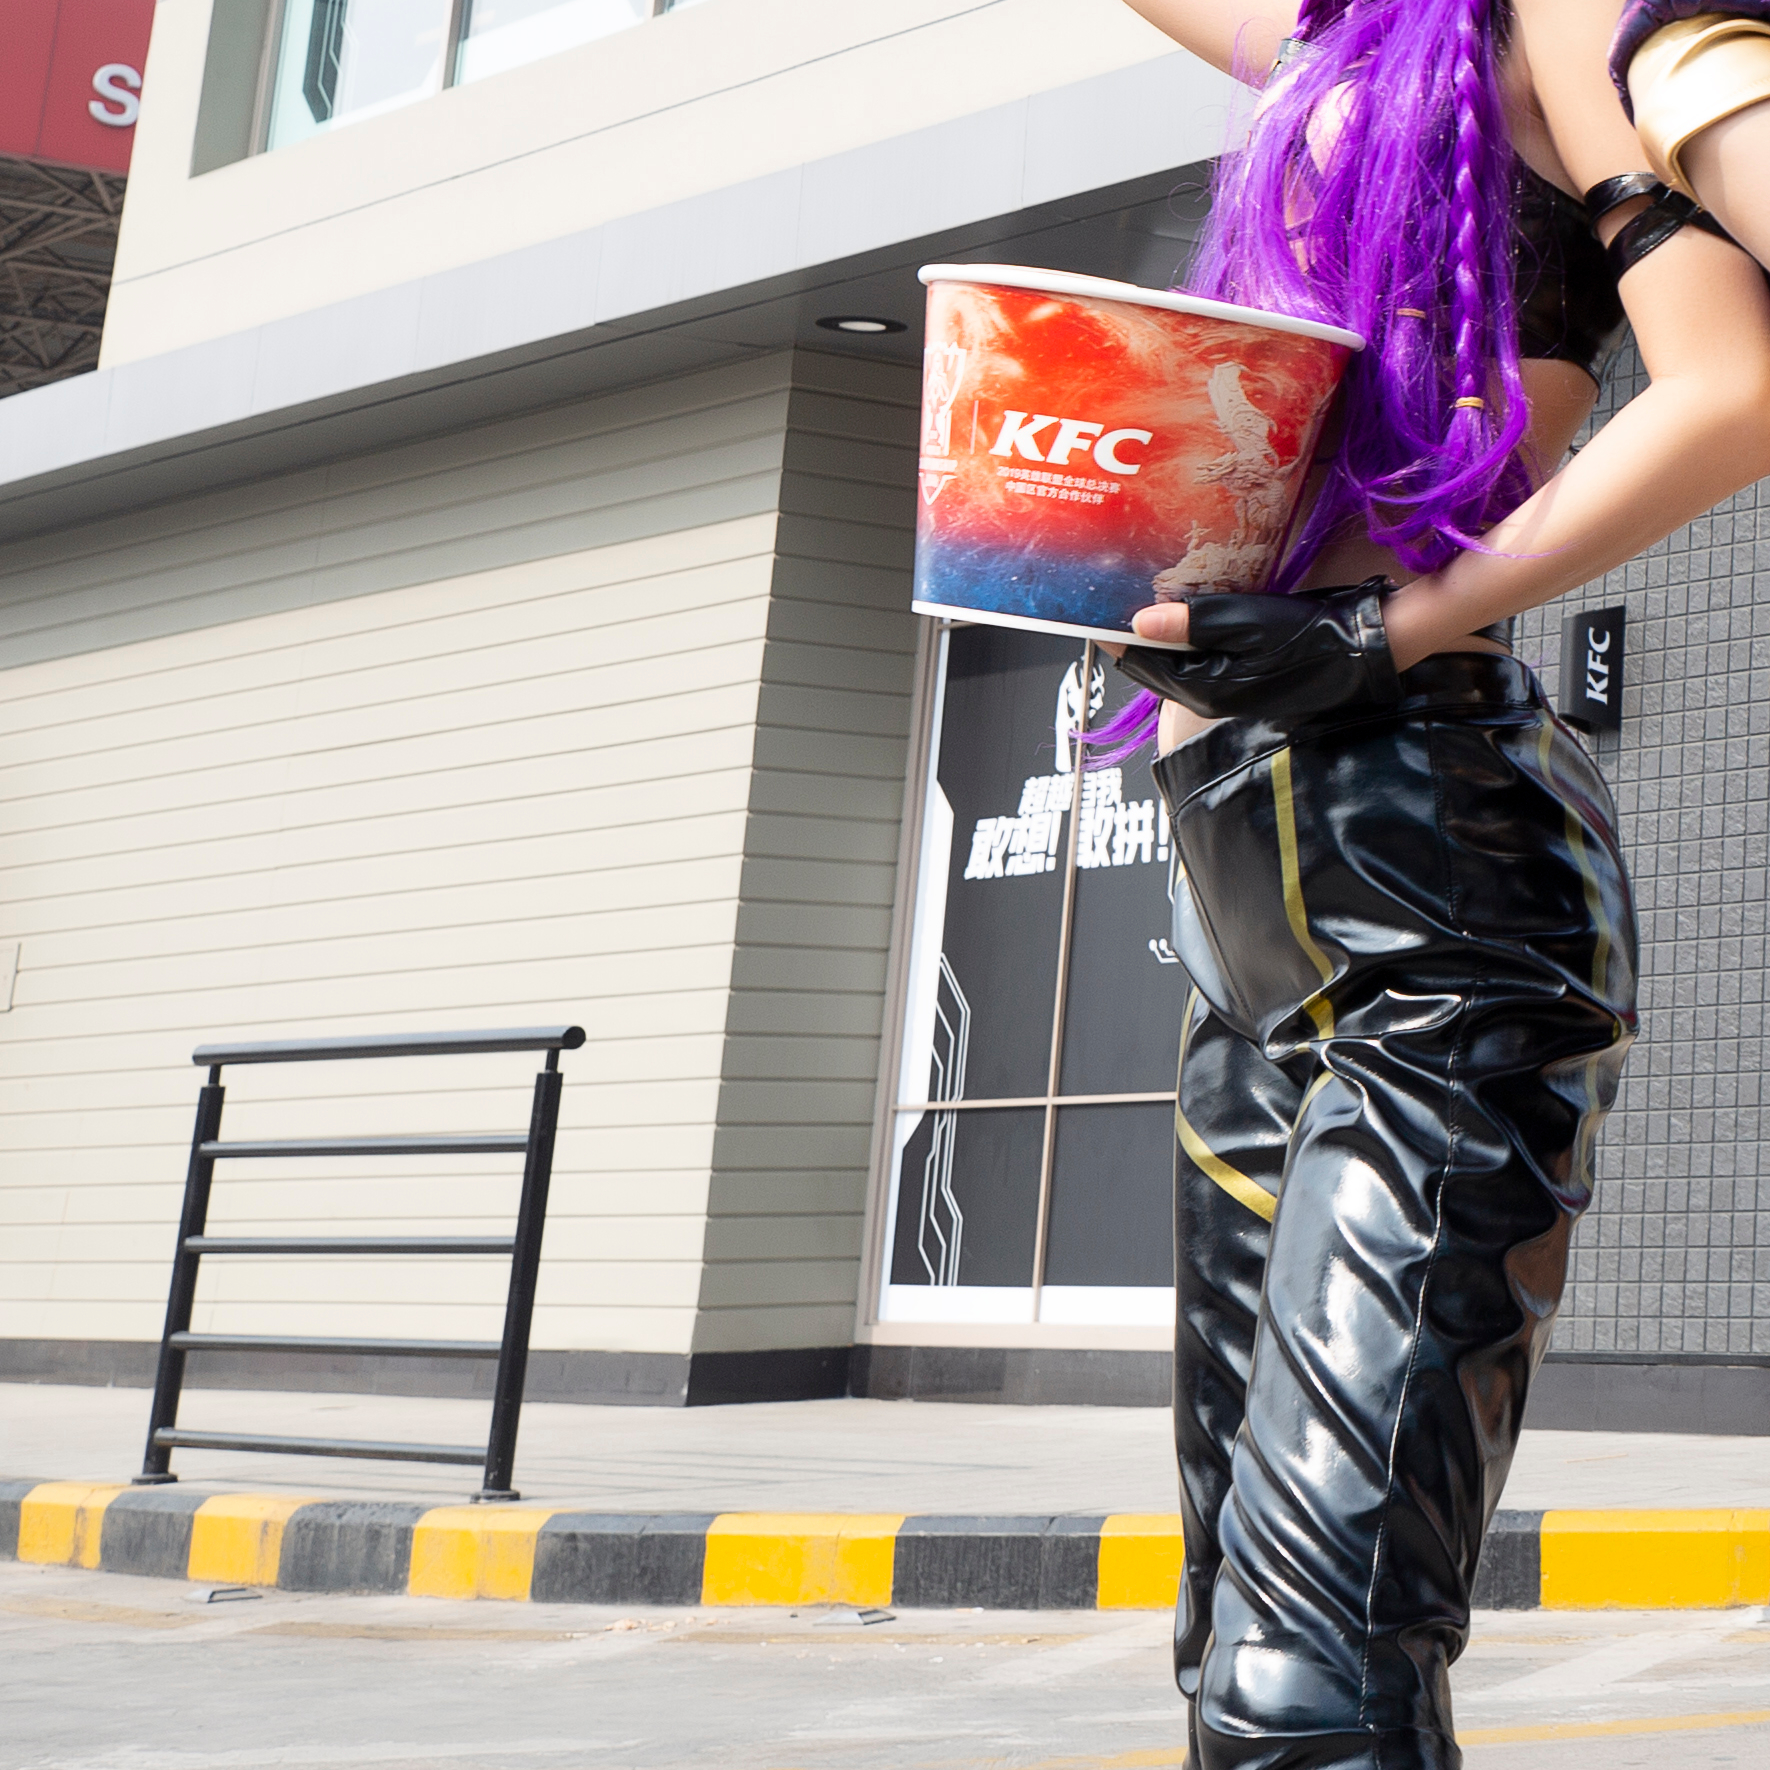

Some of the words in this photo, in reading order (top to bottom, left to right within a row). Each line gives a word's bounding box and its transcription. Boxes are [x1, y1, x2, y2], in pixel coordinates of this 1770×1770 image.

[988, 409, 1154, 476] KFC
[1005, 480, 1105, 505] 中国区官方合作伙伴
[1586, 626, 1611, 706] KFC
